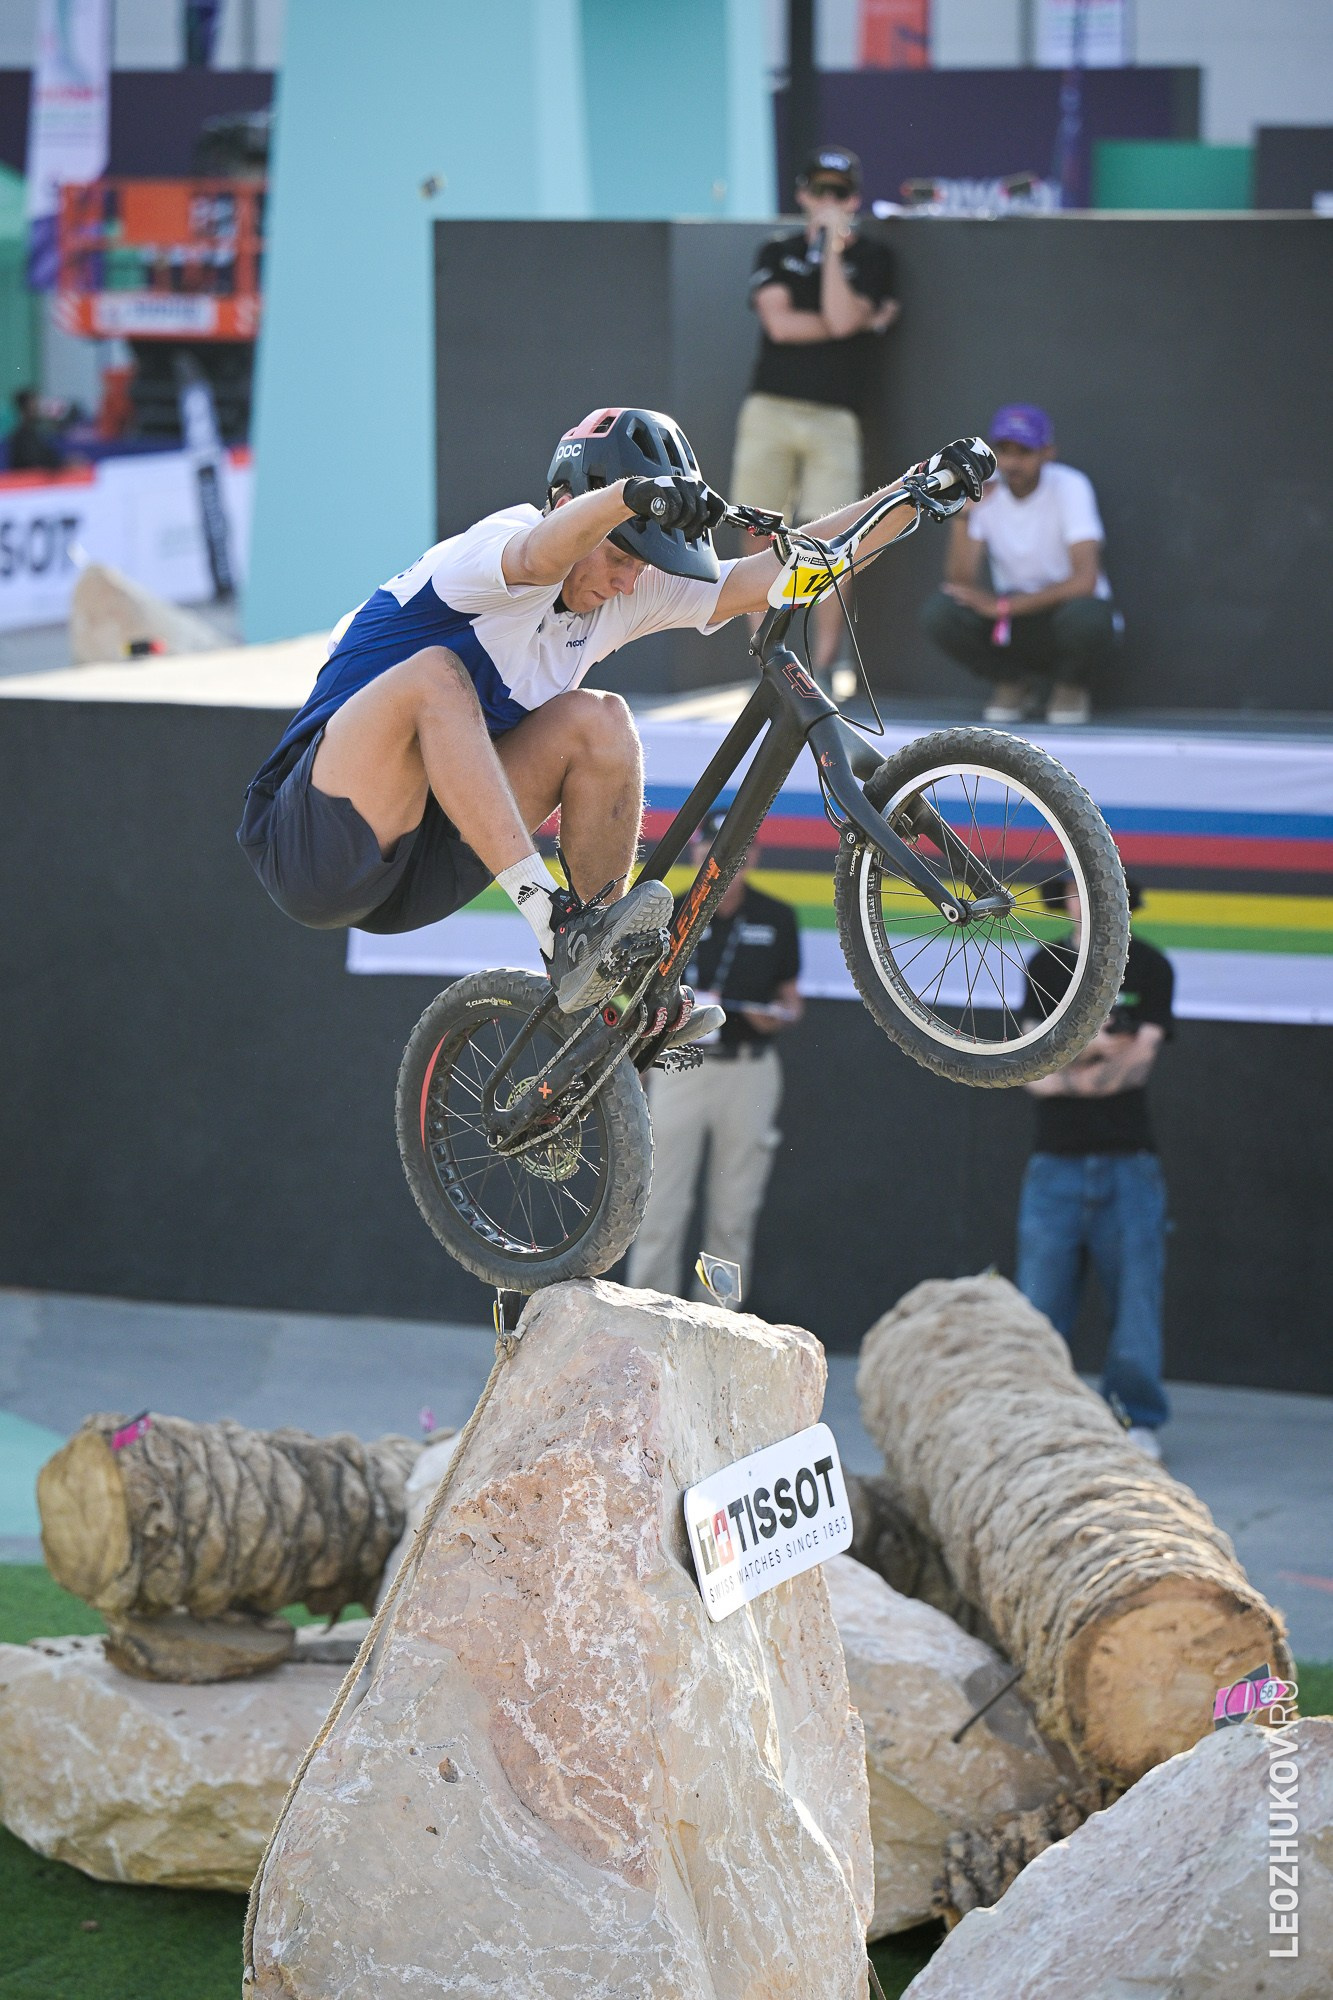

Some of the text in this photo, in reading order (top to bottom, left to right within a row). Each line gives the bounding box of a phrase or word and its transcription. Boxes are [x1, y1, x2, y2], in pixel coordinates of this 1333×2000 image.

[517, 886, 539, 906] adidas
[727, 1455, 835, 1553] TISSOT
[709, 1516, 848, 1603] SWISS WATCHES SINCE 1853
